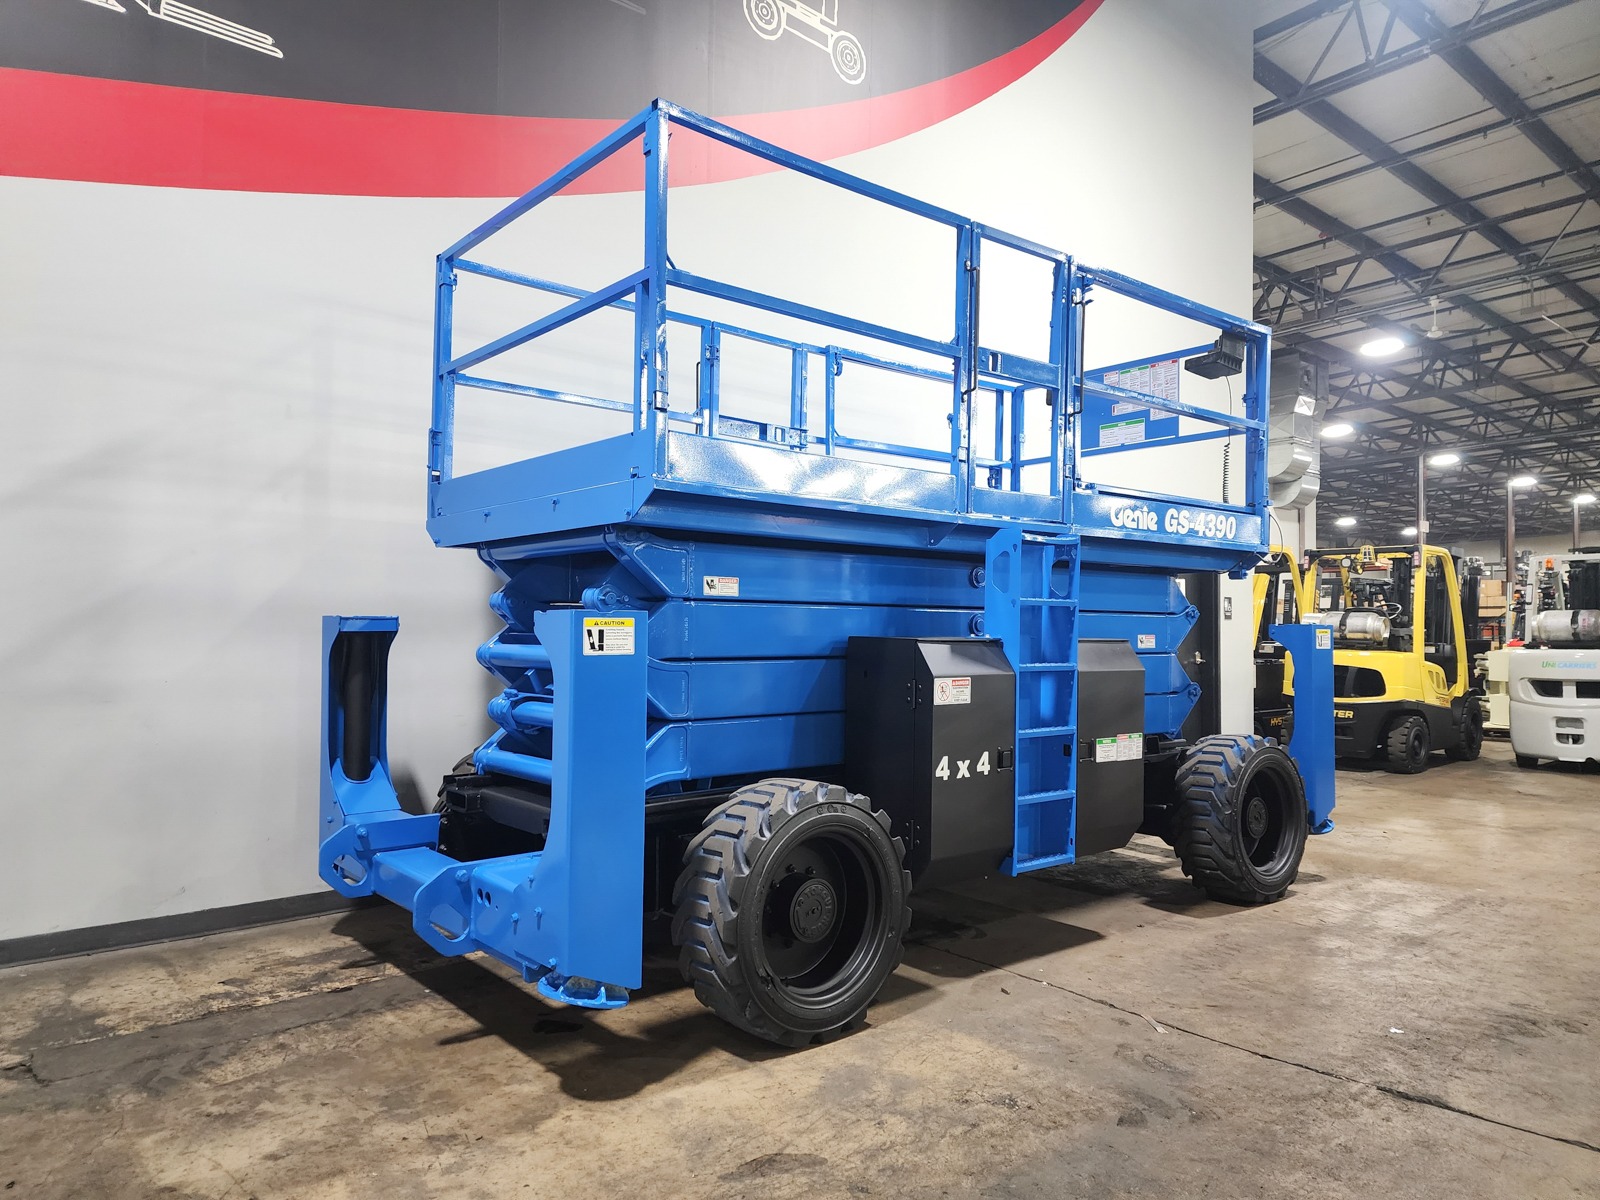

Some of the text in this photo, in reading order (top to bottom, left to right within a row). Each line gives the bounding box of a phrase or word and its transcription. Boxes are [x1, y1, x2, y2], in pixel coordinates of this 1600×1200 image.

[1110, 505, 1237, 539] Genie GS-4390
[1270, 717, 1283, 727] HYS
[1333, 709, 1354, 719] TER
[935, 755, 950, 781] 4
[976, 751, 991, 776] 4
